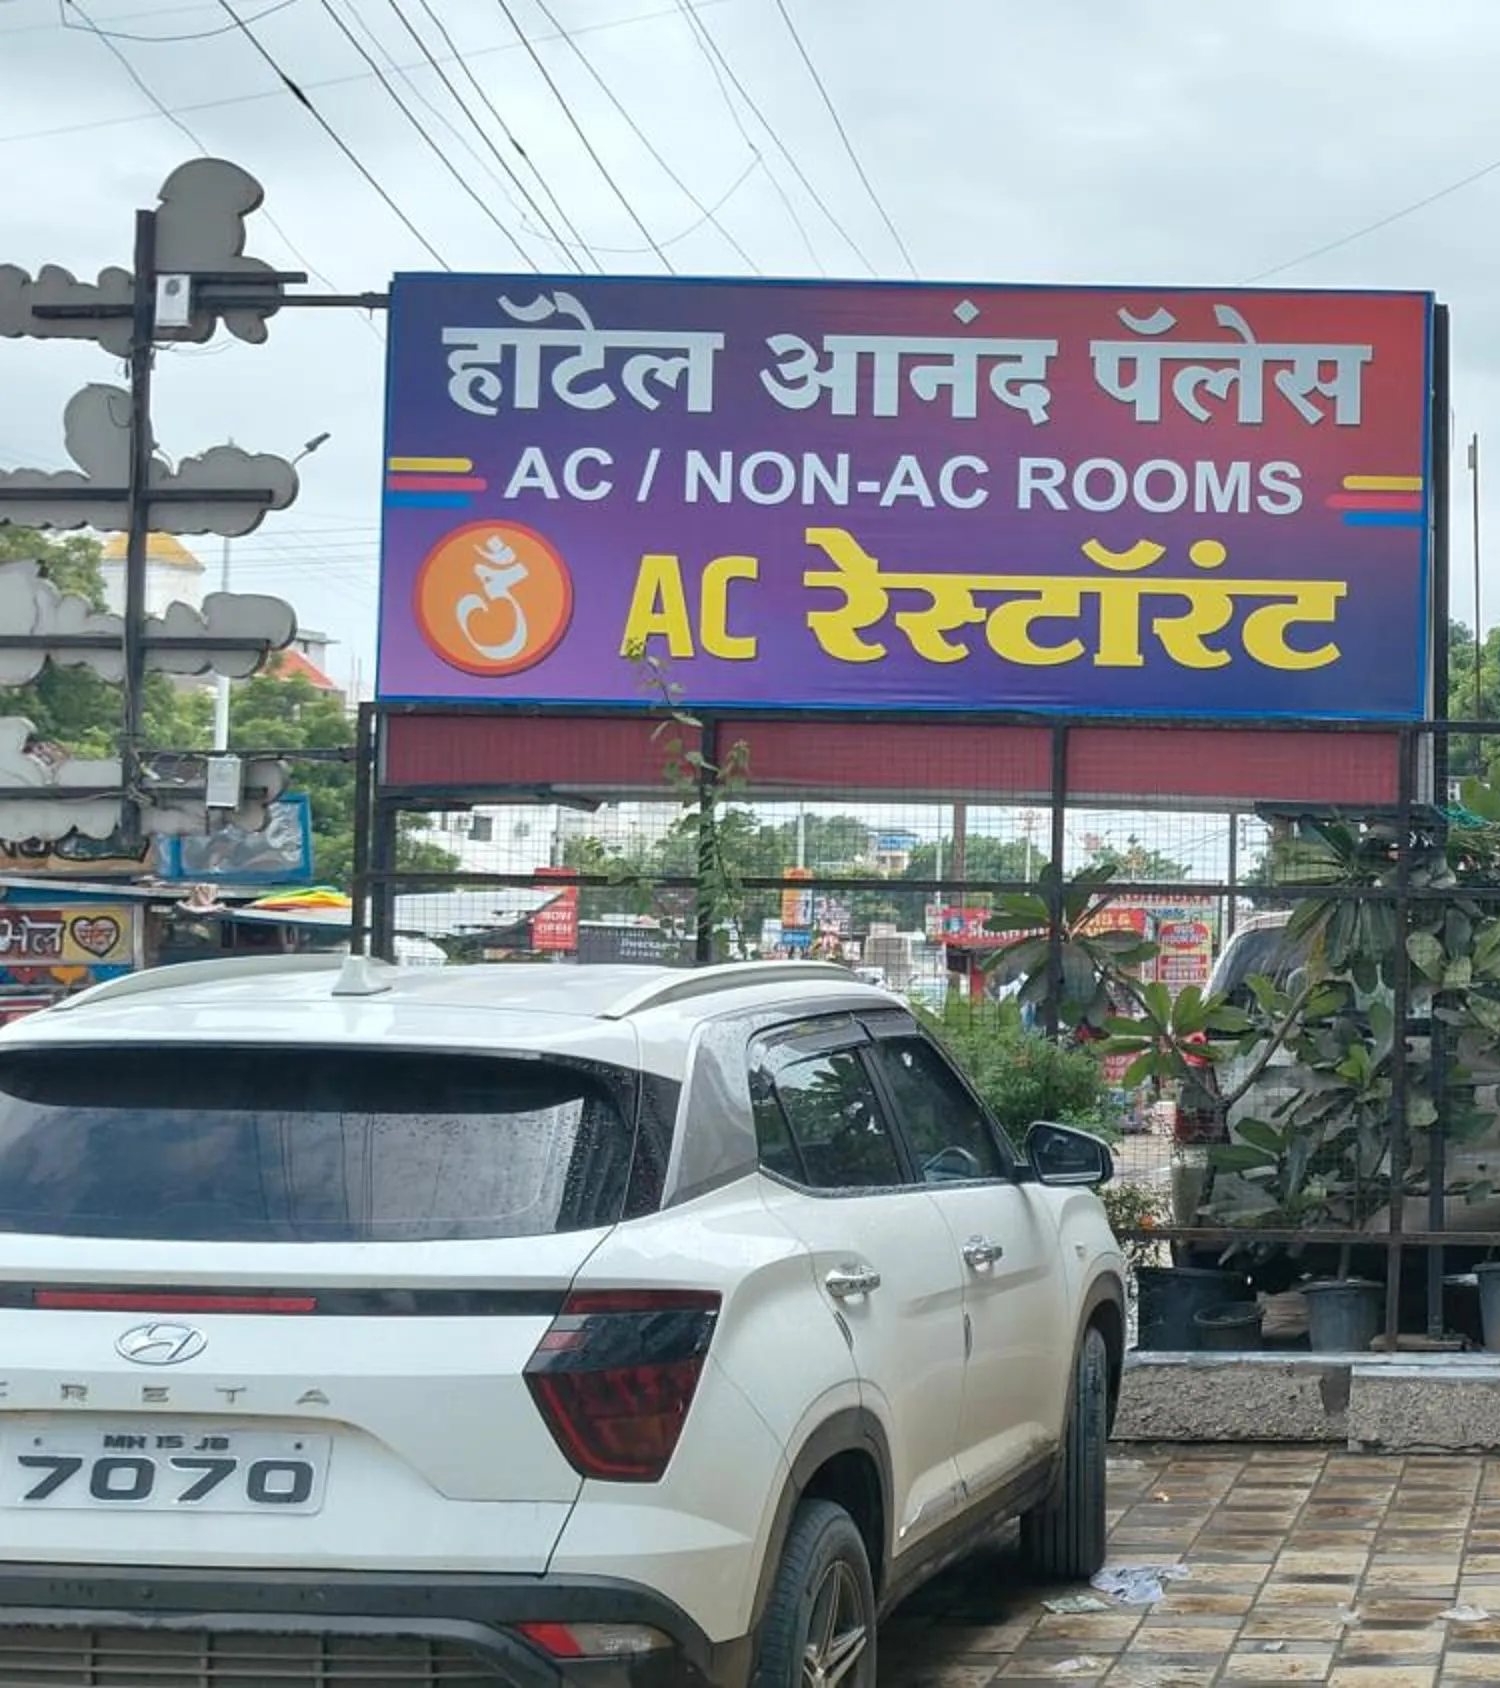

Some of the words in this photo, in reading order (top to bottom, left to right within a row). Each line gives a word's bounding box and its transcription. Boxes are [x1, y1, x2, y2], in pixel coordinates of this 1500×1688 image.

[442, 292, 725, 416] हॉटेल
[760, 300, 1058, 425] आनंद
[1090, 305, 1372, 426] पॅलेस
[504, 447, 613, 501] AC
[637, 448, 660, 504] /
[685, 450, 990, 510] NON-AC
[1018, 457, 1303, 515] ROOMS
[621, 555, 759, 660] AC
[803, 528, 1347, 671] रेस्टॉरंट
[0, 1381, 330, 1405] RETA
[156, 1436, 184, 1449] 15
[17, 1456, 313, 1503] 7070
